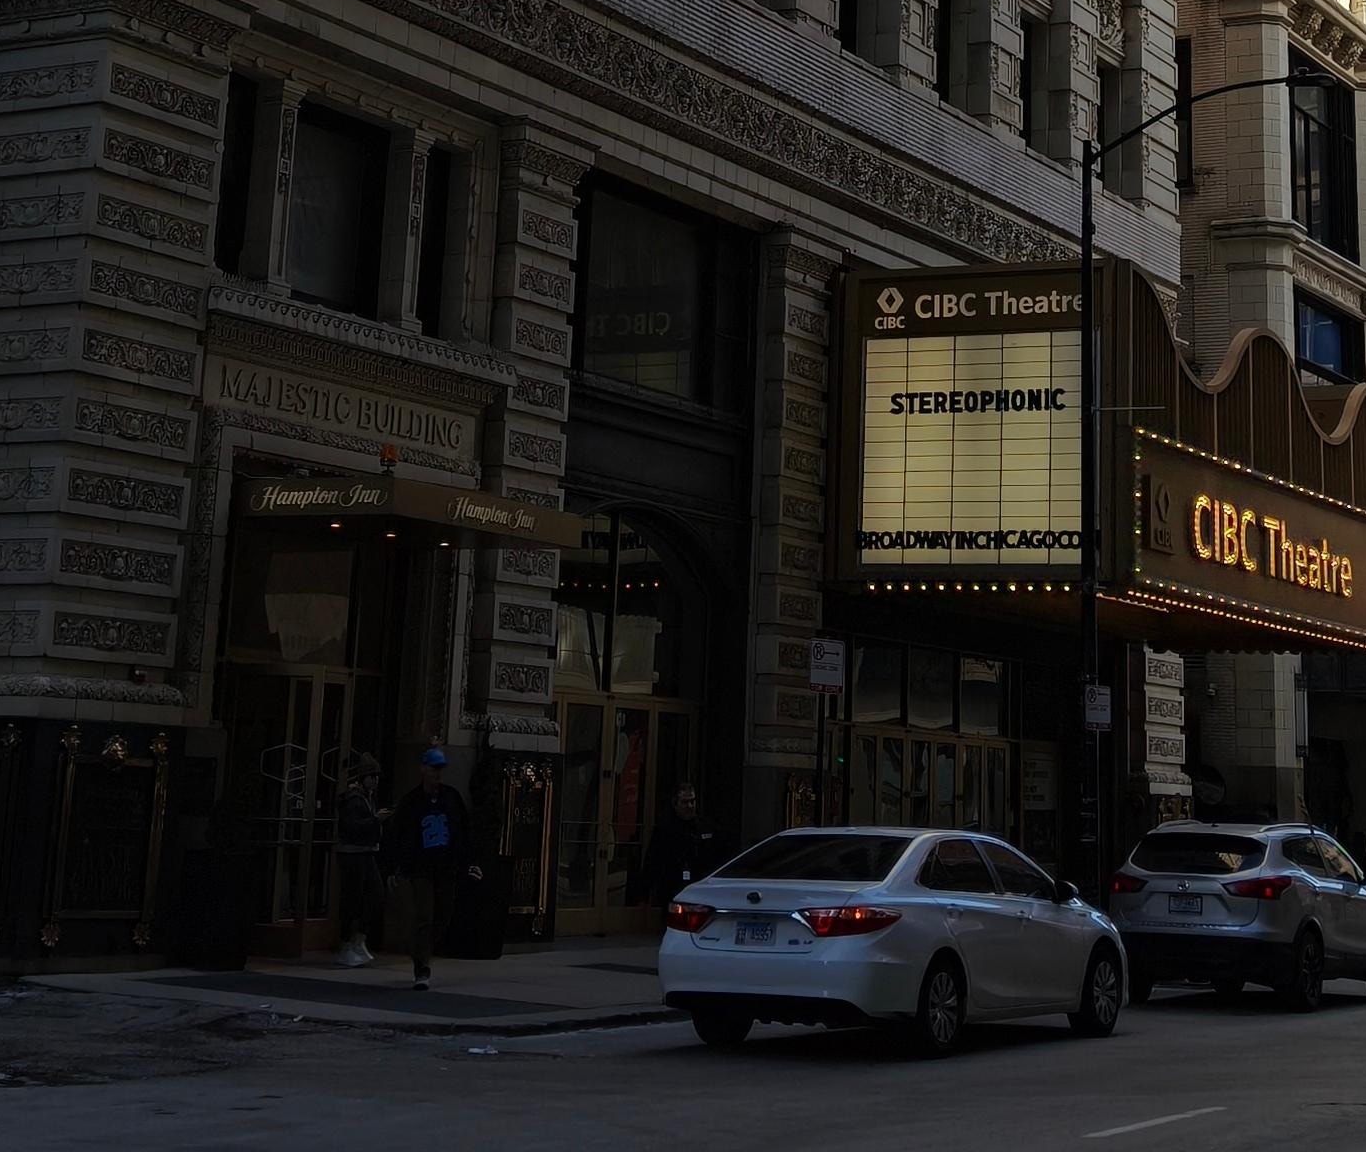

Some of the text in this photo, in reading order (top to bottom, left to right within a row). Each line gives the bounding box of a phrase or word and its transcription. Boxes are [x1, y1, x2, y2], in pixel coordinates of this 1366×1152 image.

[914, 289, 1082, 319] CIBC Theatre
[875, 315, 906, 330] CIBC
[220, 364, 462, 449] MAJESTIC BUILDING
[890, 388, 1066, 415] STEREOPHONIC
[250, 483, 387, 512] Hampton Inn
[447, 495, 537, 531] Hampton Inn
[1193, 493, 1353, 599] CIBC Theatre
